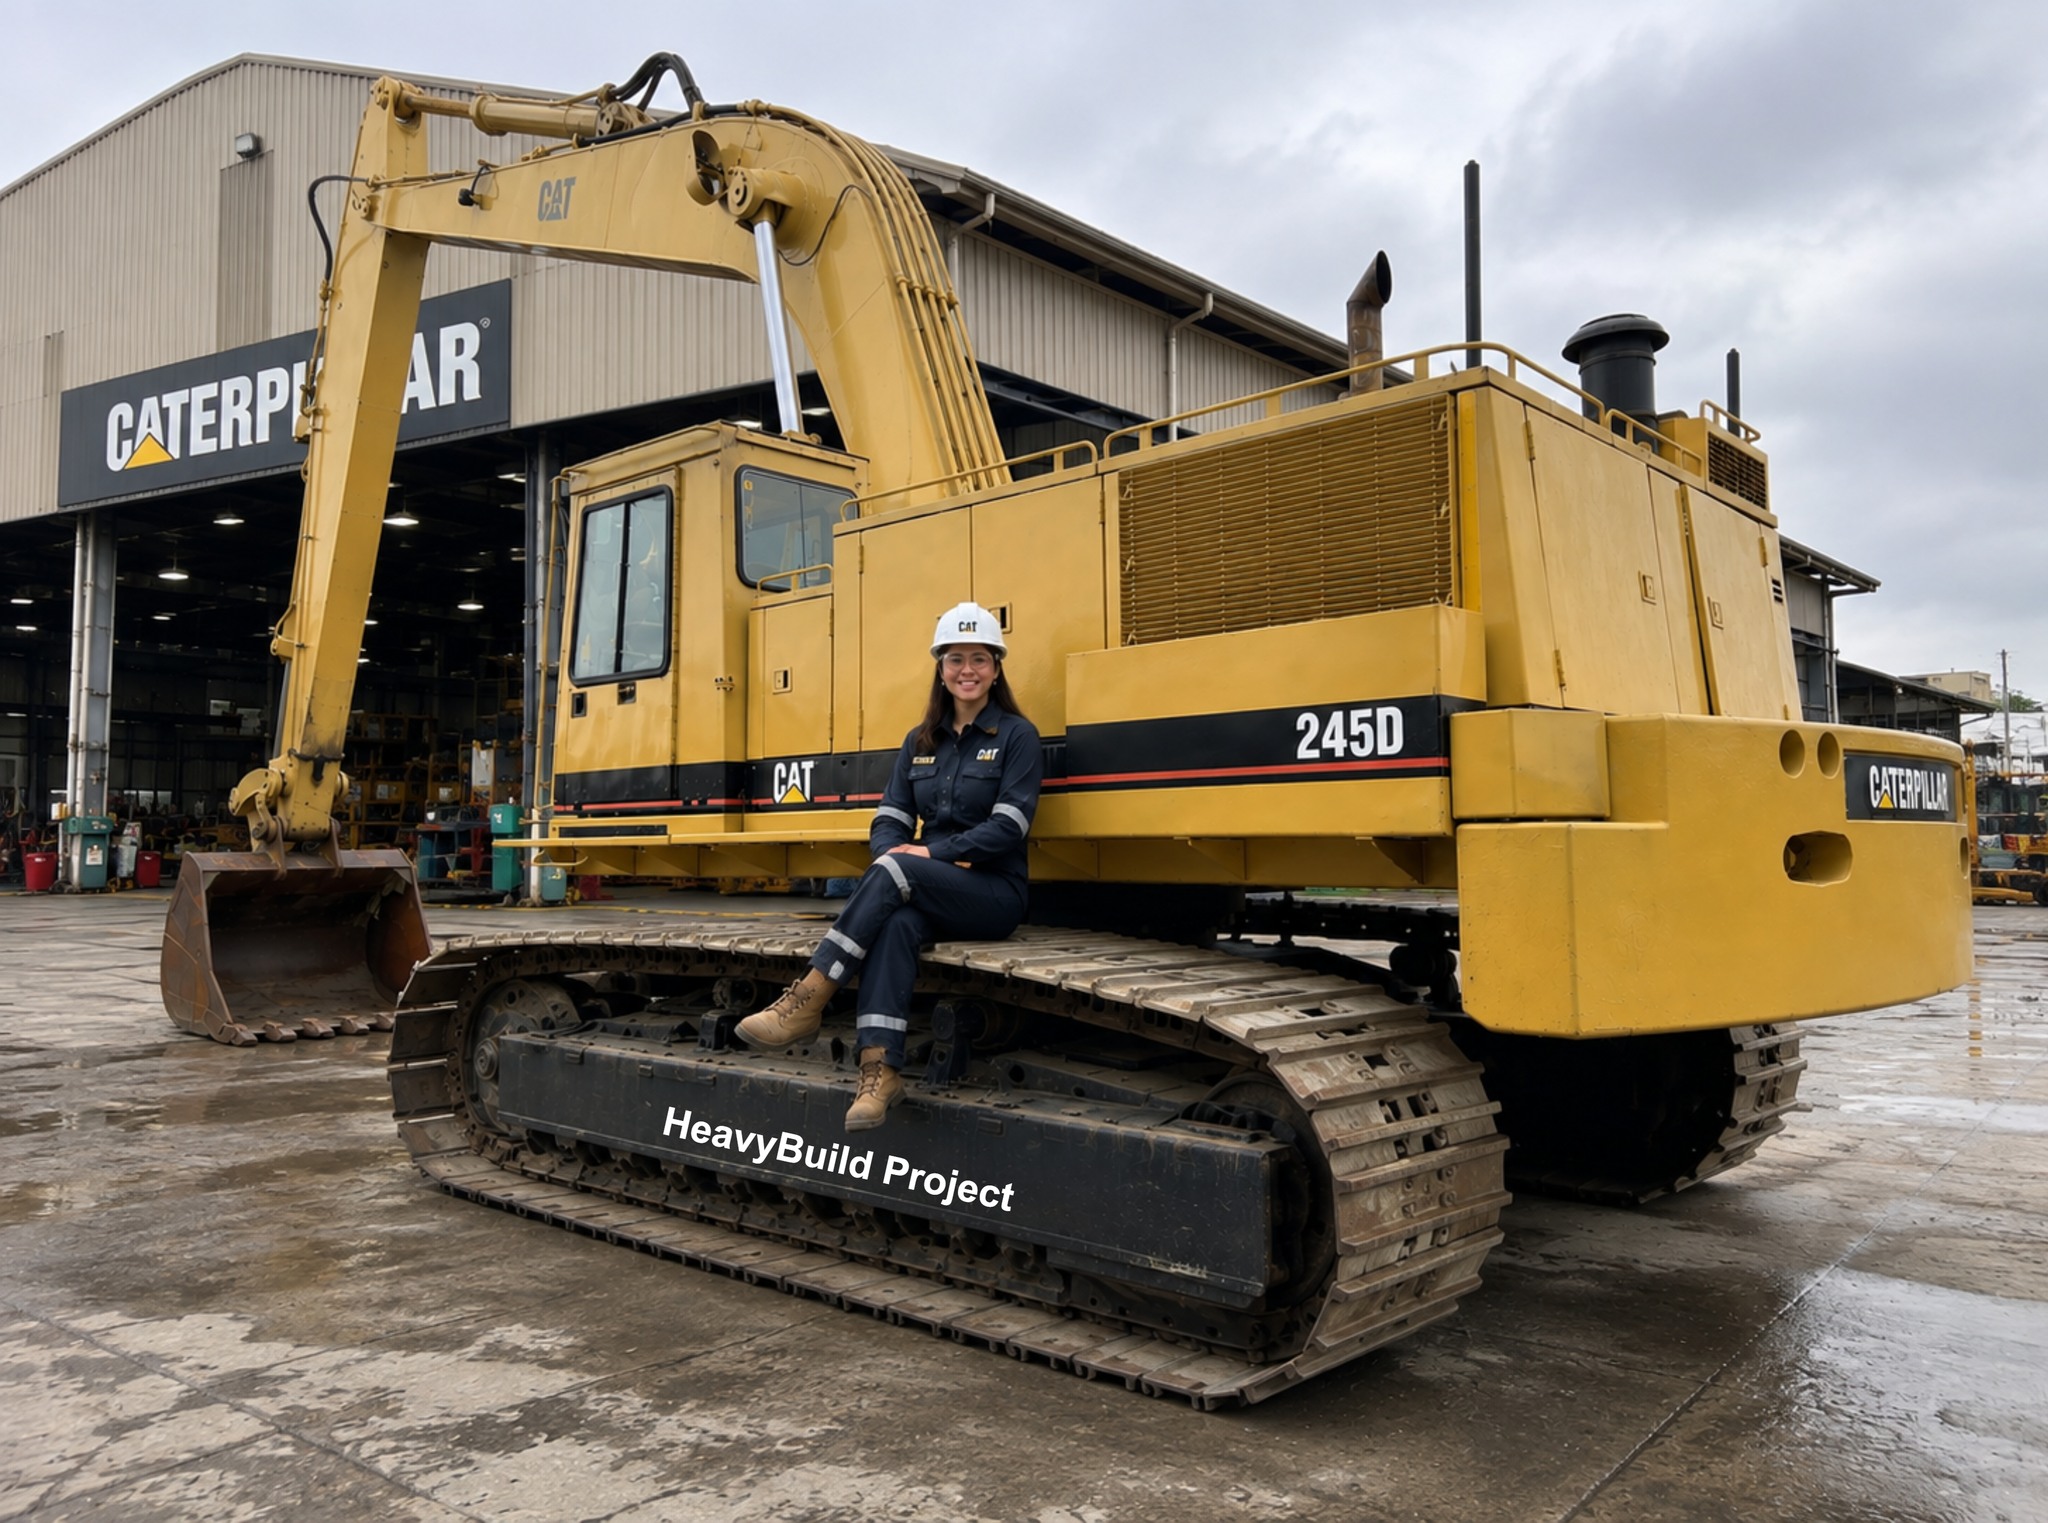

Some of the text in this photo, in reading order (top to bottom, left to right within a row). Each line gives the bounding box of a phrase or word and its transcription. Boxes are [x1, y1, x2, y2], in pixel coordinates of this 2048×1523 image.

[538, 176, 577, 222] CAT
[958, 620, 978, 633] CAT
[1296, 706, 1404, 759] 245D
[773, 760, 815, 804] CAT
[1869, 764, 1949, 811] CATERPILLAR
[662, 1106, 1015, 1212] HeavyBuild Project
